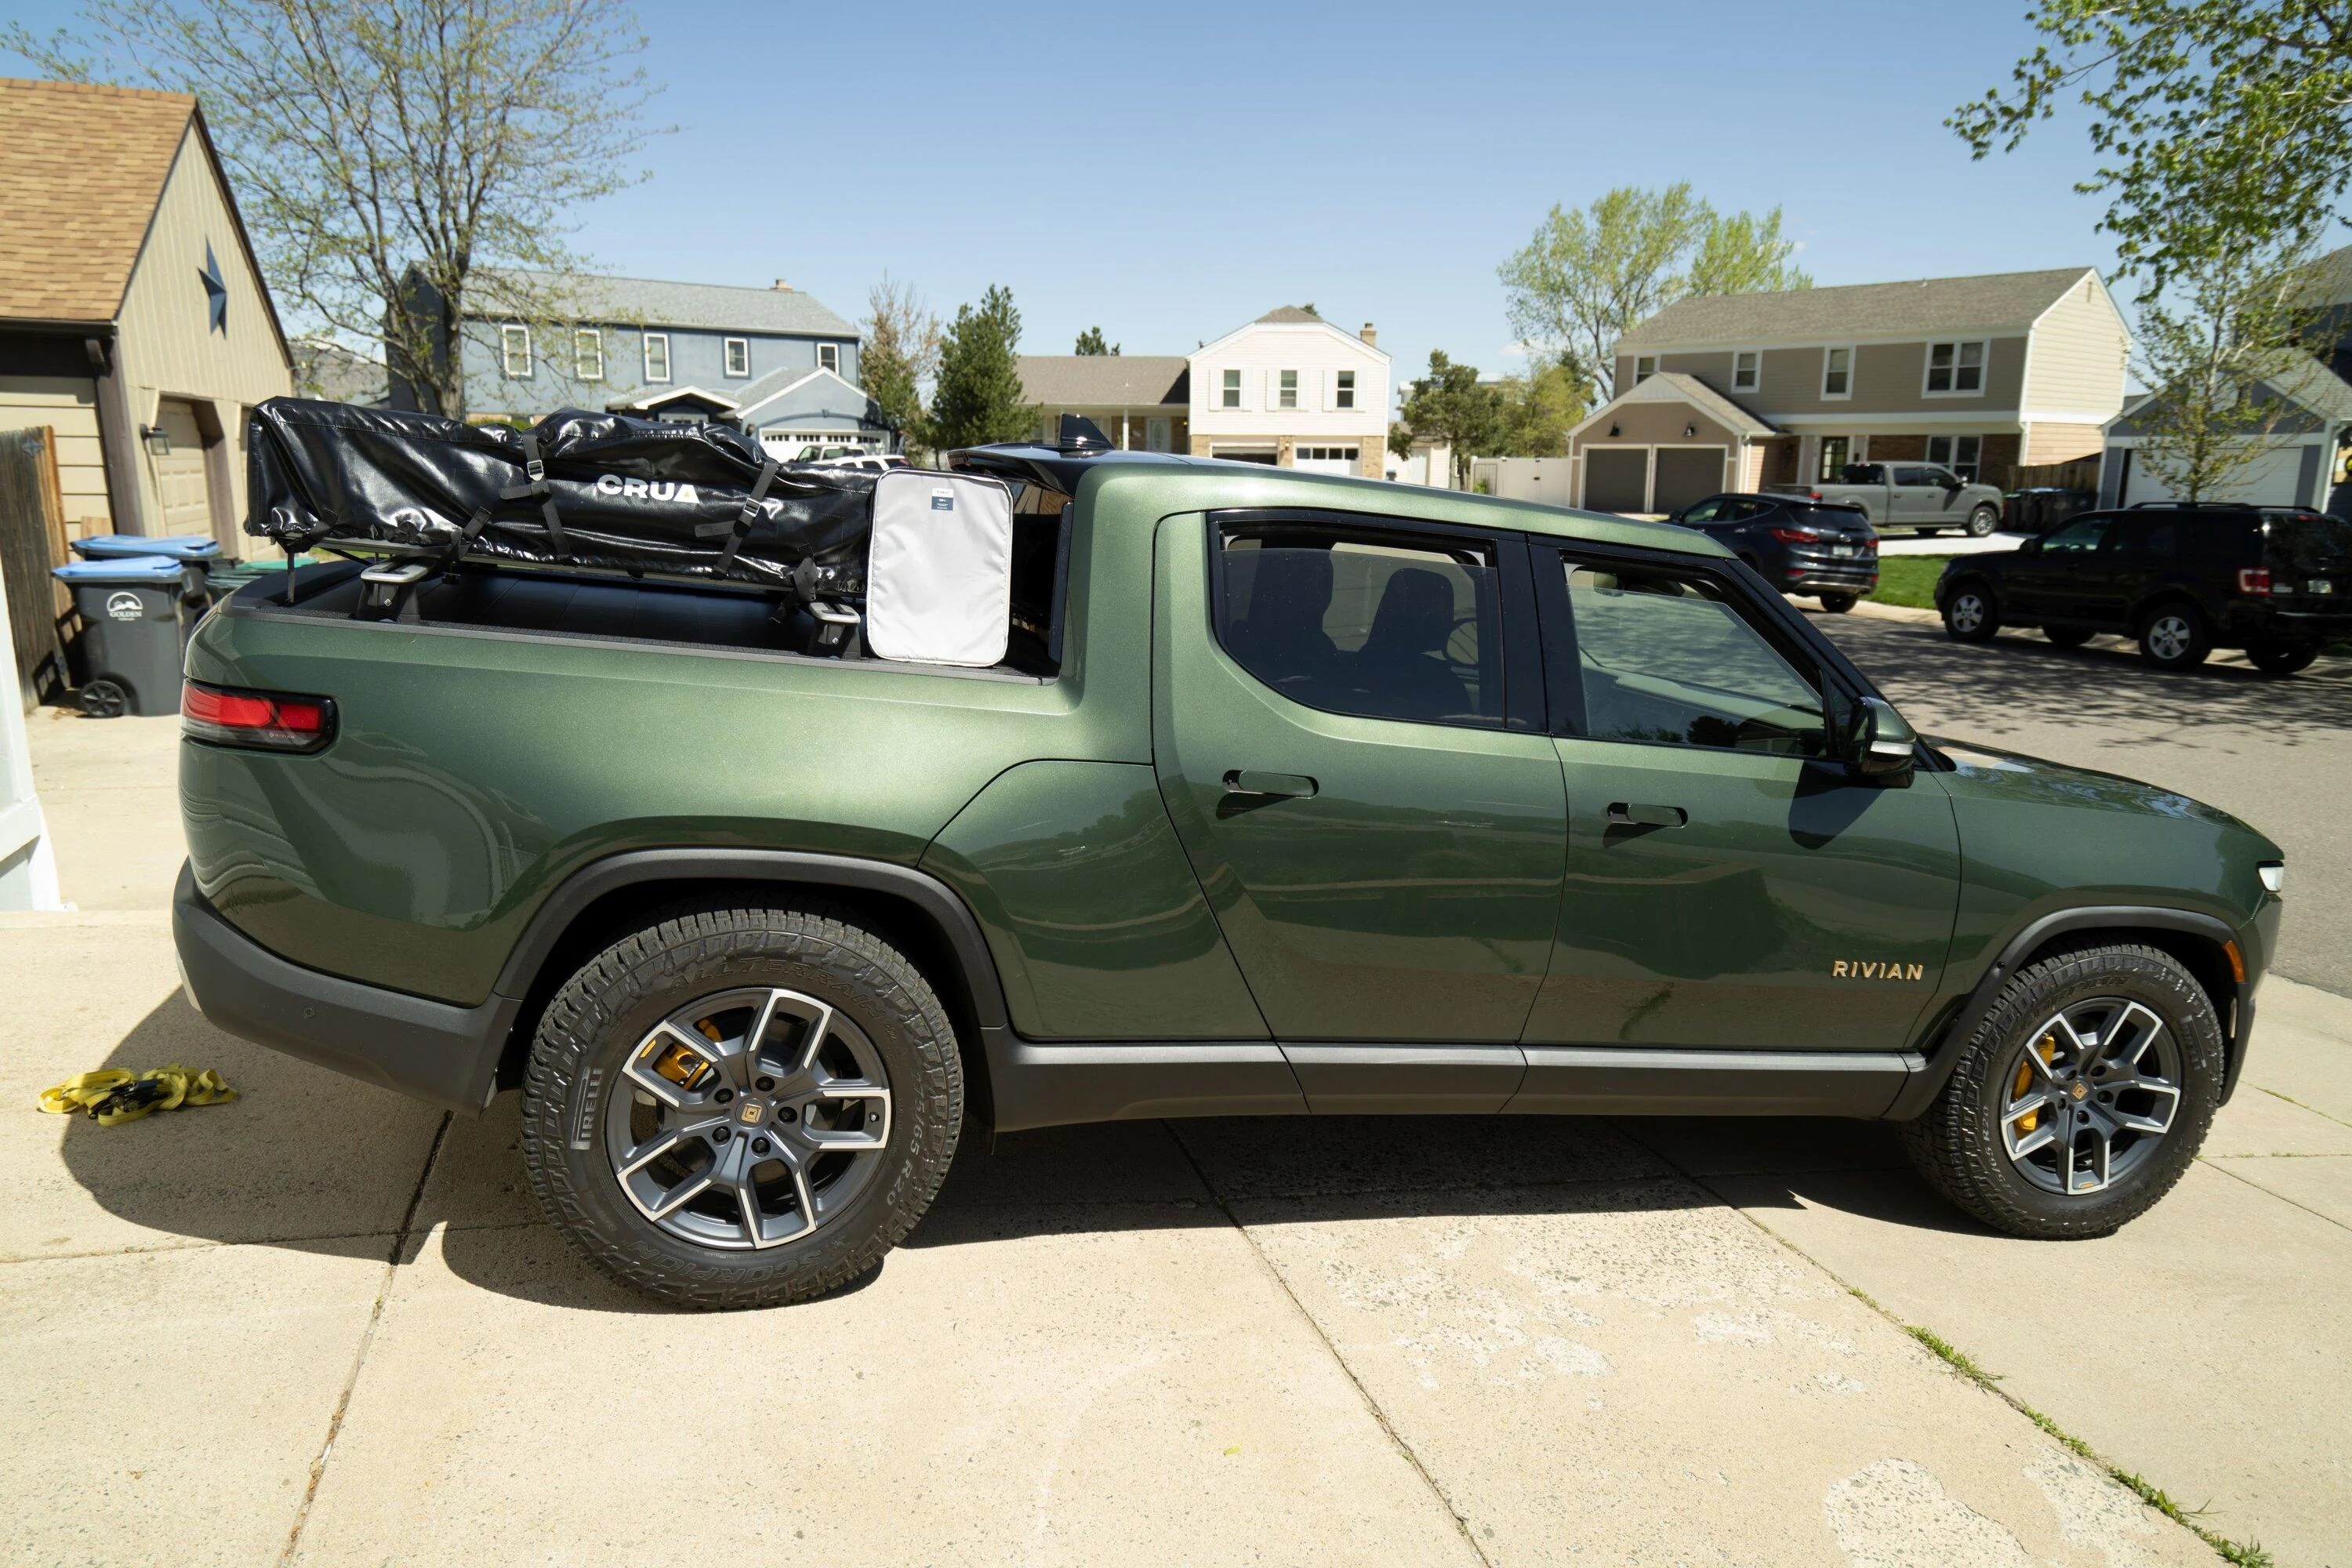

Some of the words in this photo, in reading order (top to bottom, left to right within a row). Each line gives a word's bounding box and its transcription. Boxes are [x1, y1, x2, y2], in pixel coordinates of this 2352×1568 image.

[597, 474, 700, 504] CRUA
[1831, 960, 1923, 980] RIVIAN
[571, 1066, 603, 1150] PIRELLI
[909, 1067, 926, 1156] 275/65
[887, 1159, 913, 1206] R20
[626, 1240, 824, 1283] SCORPION
